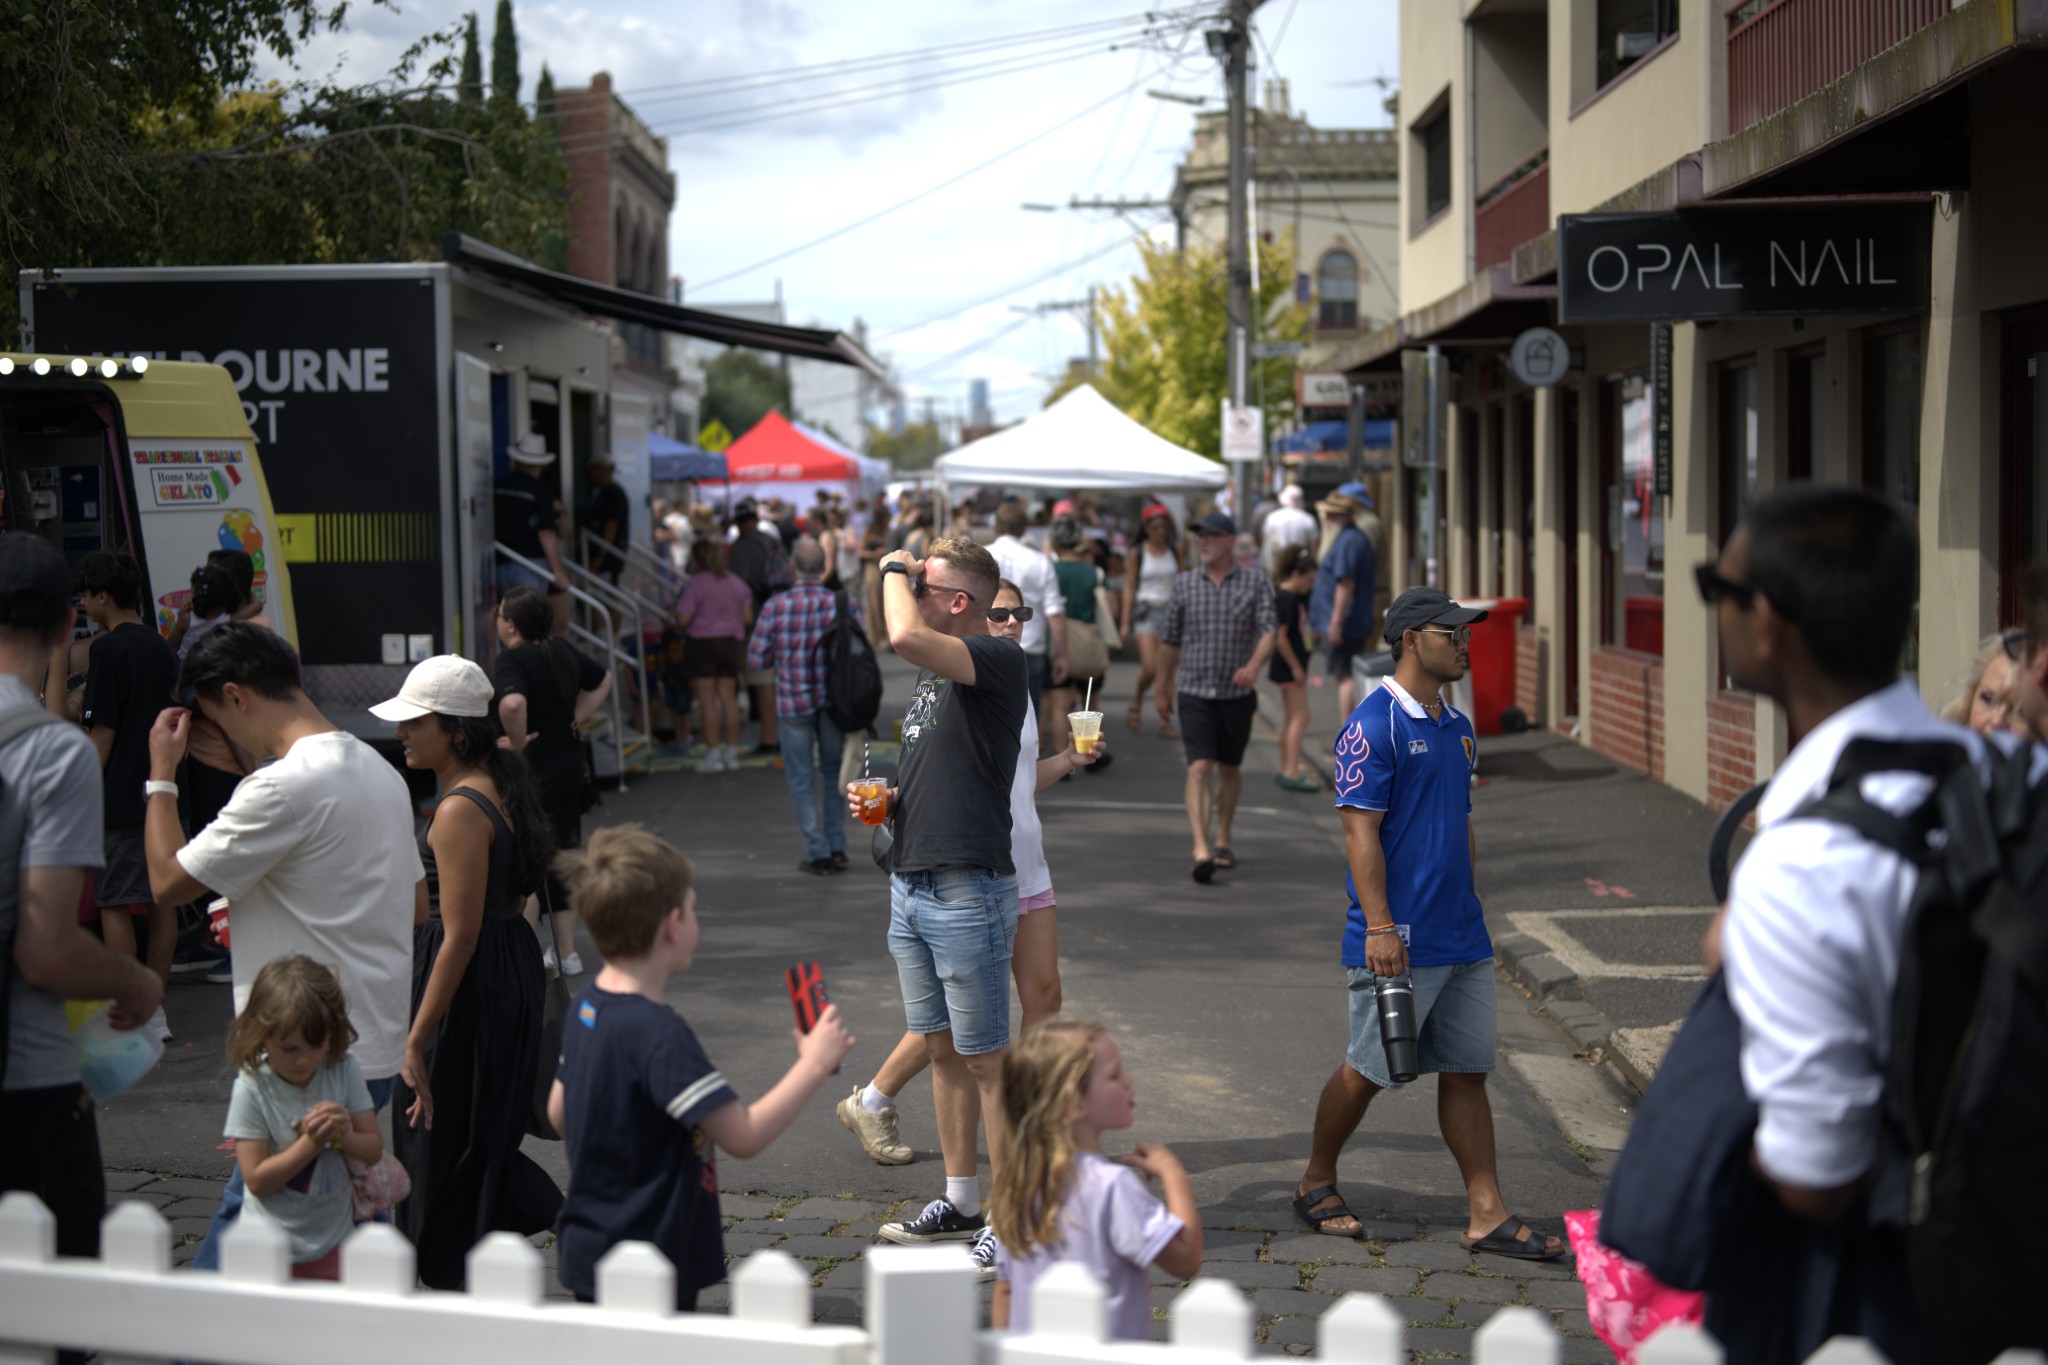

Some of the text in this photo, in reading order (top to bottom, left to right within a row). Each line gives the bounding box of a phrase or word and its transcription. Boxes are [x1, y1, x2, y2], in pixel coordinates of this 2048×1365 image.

[1587, 237, 1898, 293] OPAL NAIL
[92, 348, 390, 394] OURNE
[133, 449, 243, 465] TRADITIONAL ITALIAN
[157, 471, 209, 482] Home Made
[159, 483, 213, 500] GELATO
